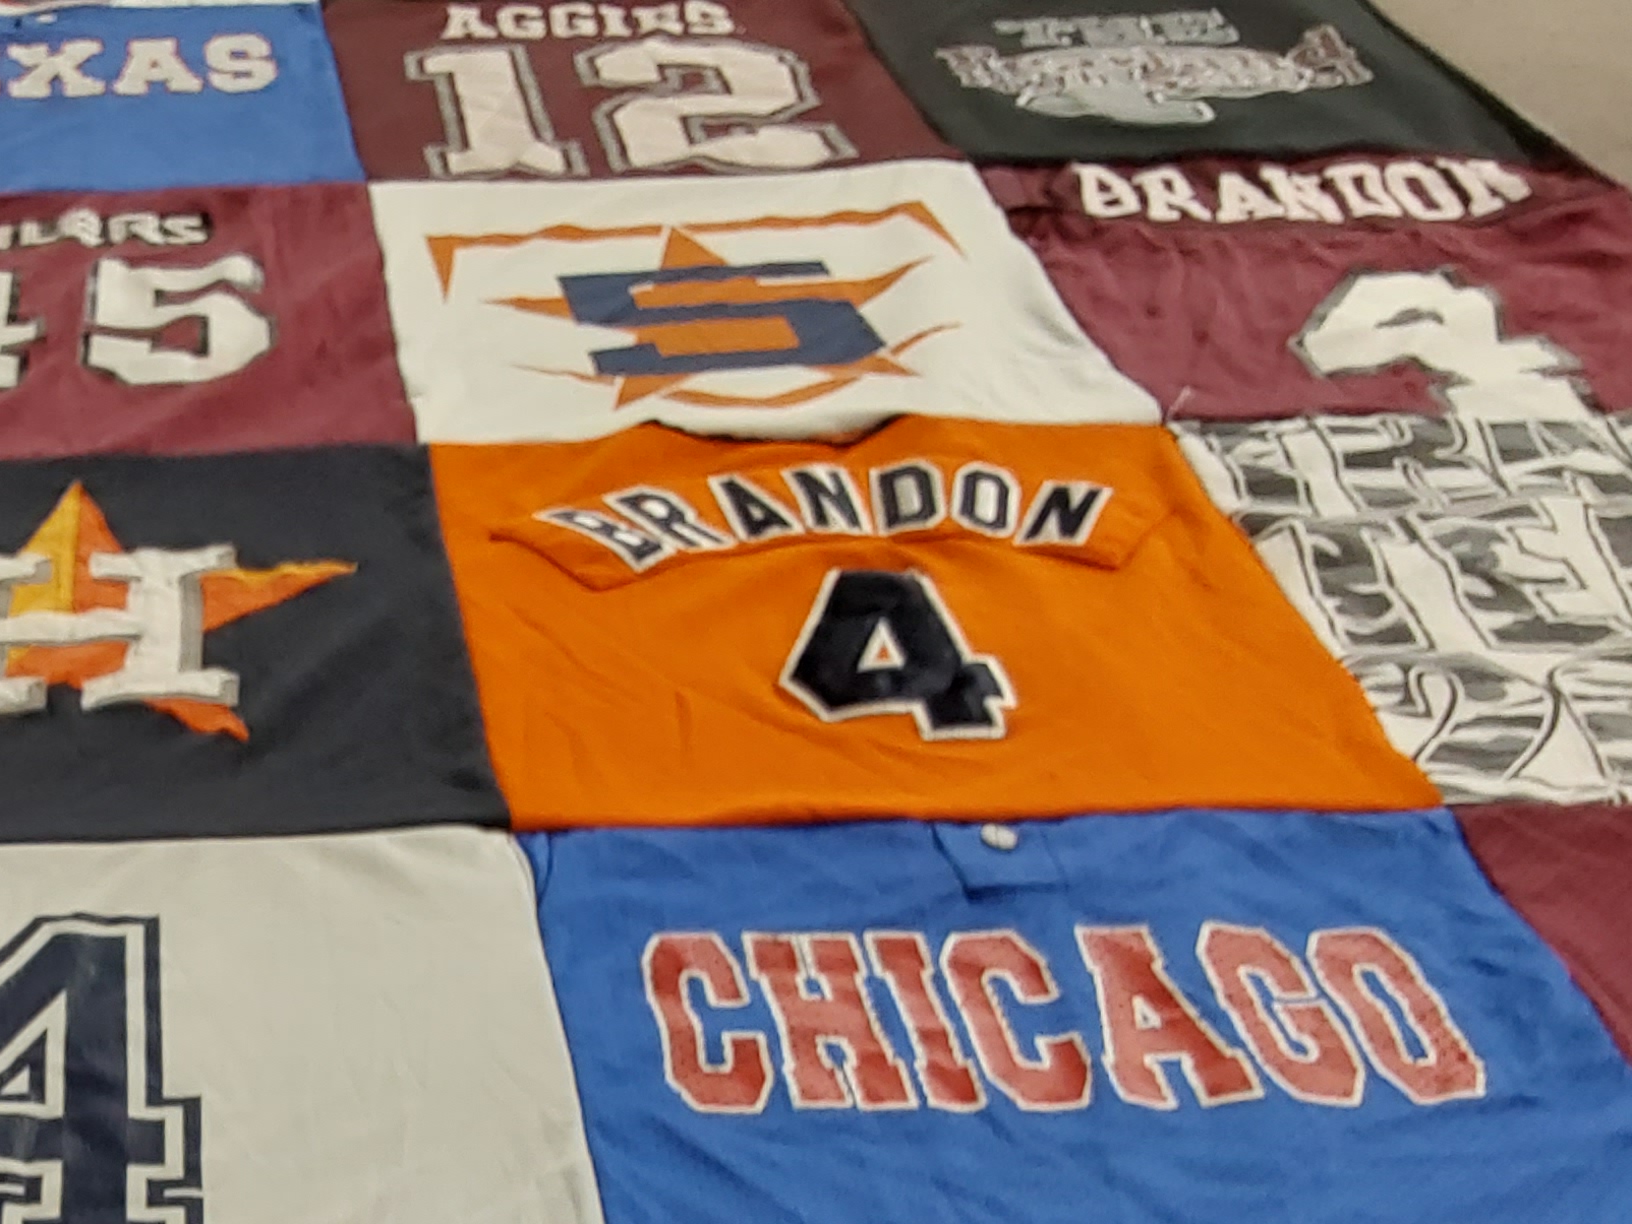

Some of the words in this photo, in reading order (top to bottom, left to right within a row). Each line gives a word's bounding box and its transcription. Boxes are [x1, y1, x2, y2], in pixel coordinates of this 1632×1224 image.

[440, 0, 735, 40] AGGIES
[403, 35, 858, 178] 12
[1072, 157, 1531, 224] BRANDON
[532, 461, 1114, 573] BRANDON
[779, 567, 1018, 742] 4
[641, 920, 1488, 1115] CHICAGO
